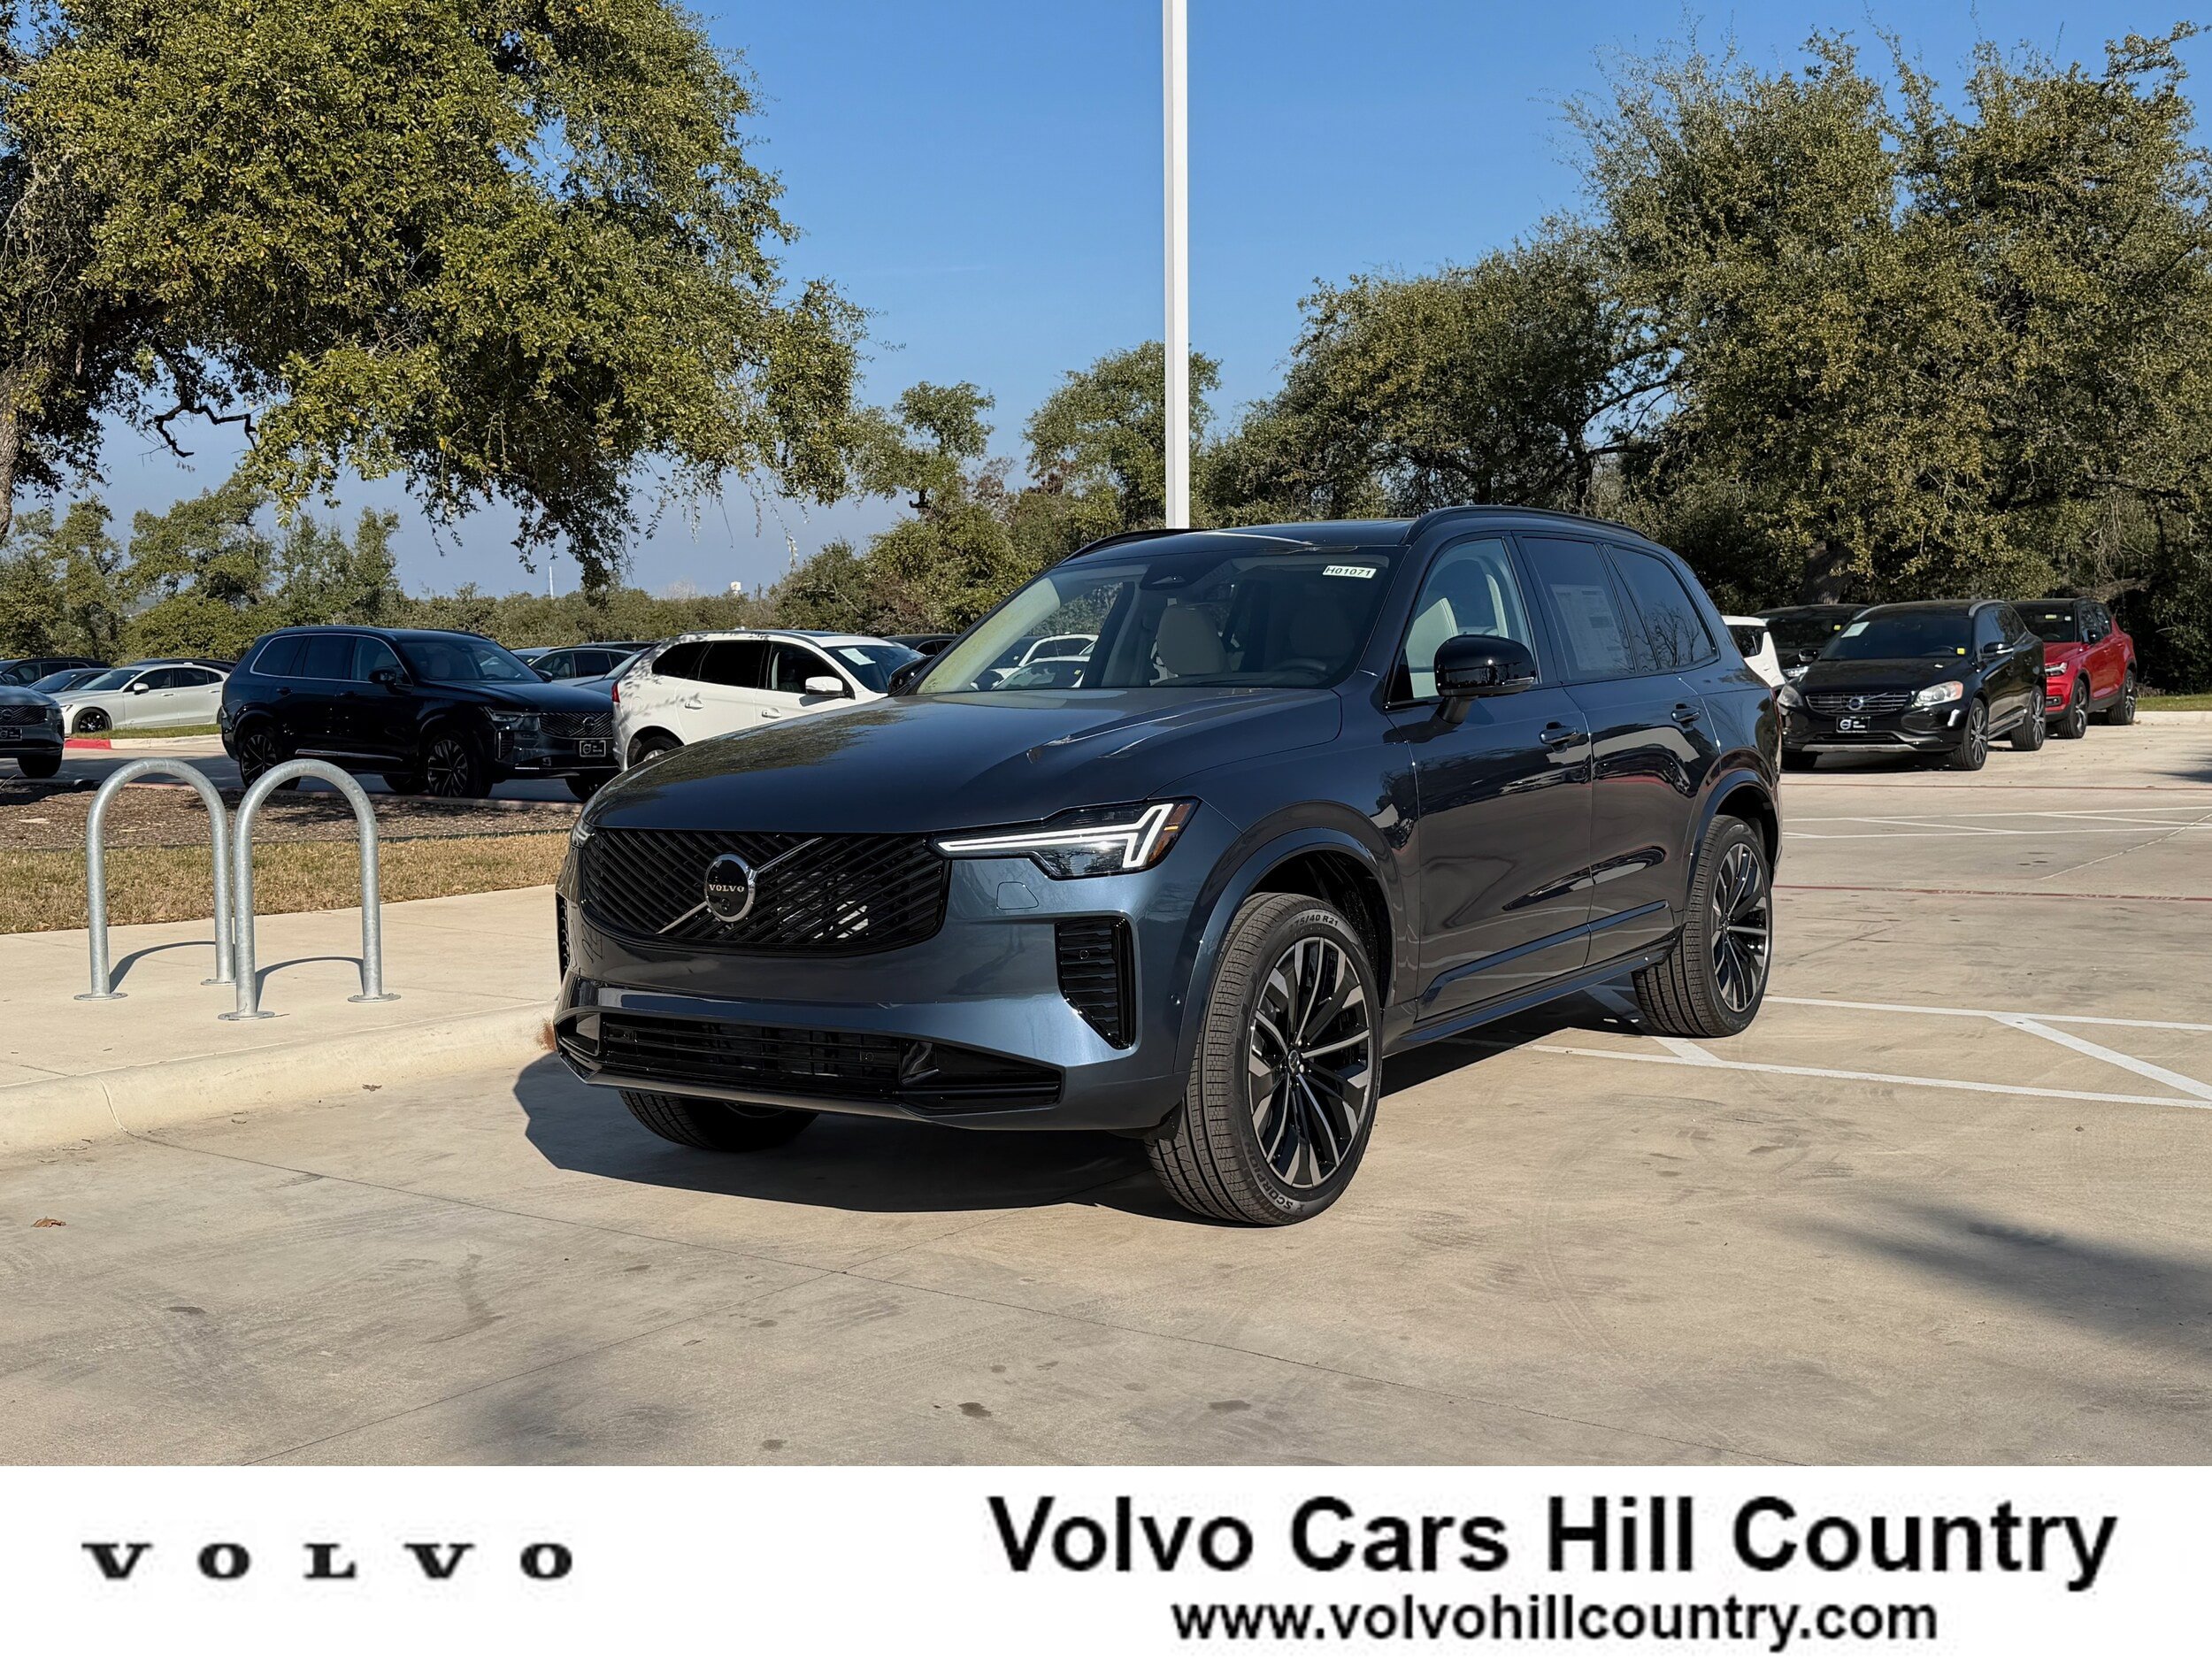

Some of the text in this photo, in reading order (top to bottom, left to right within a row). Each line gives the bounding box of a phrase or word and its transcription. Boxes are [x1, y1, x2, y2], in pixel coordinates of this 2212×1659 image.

[1325, 567, 1371, 577] H01071
[1322, 915, 1339, 926] R21
[1244, 1141, 1294, 1210] SCORPION
